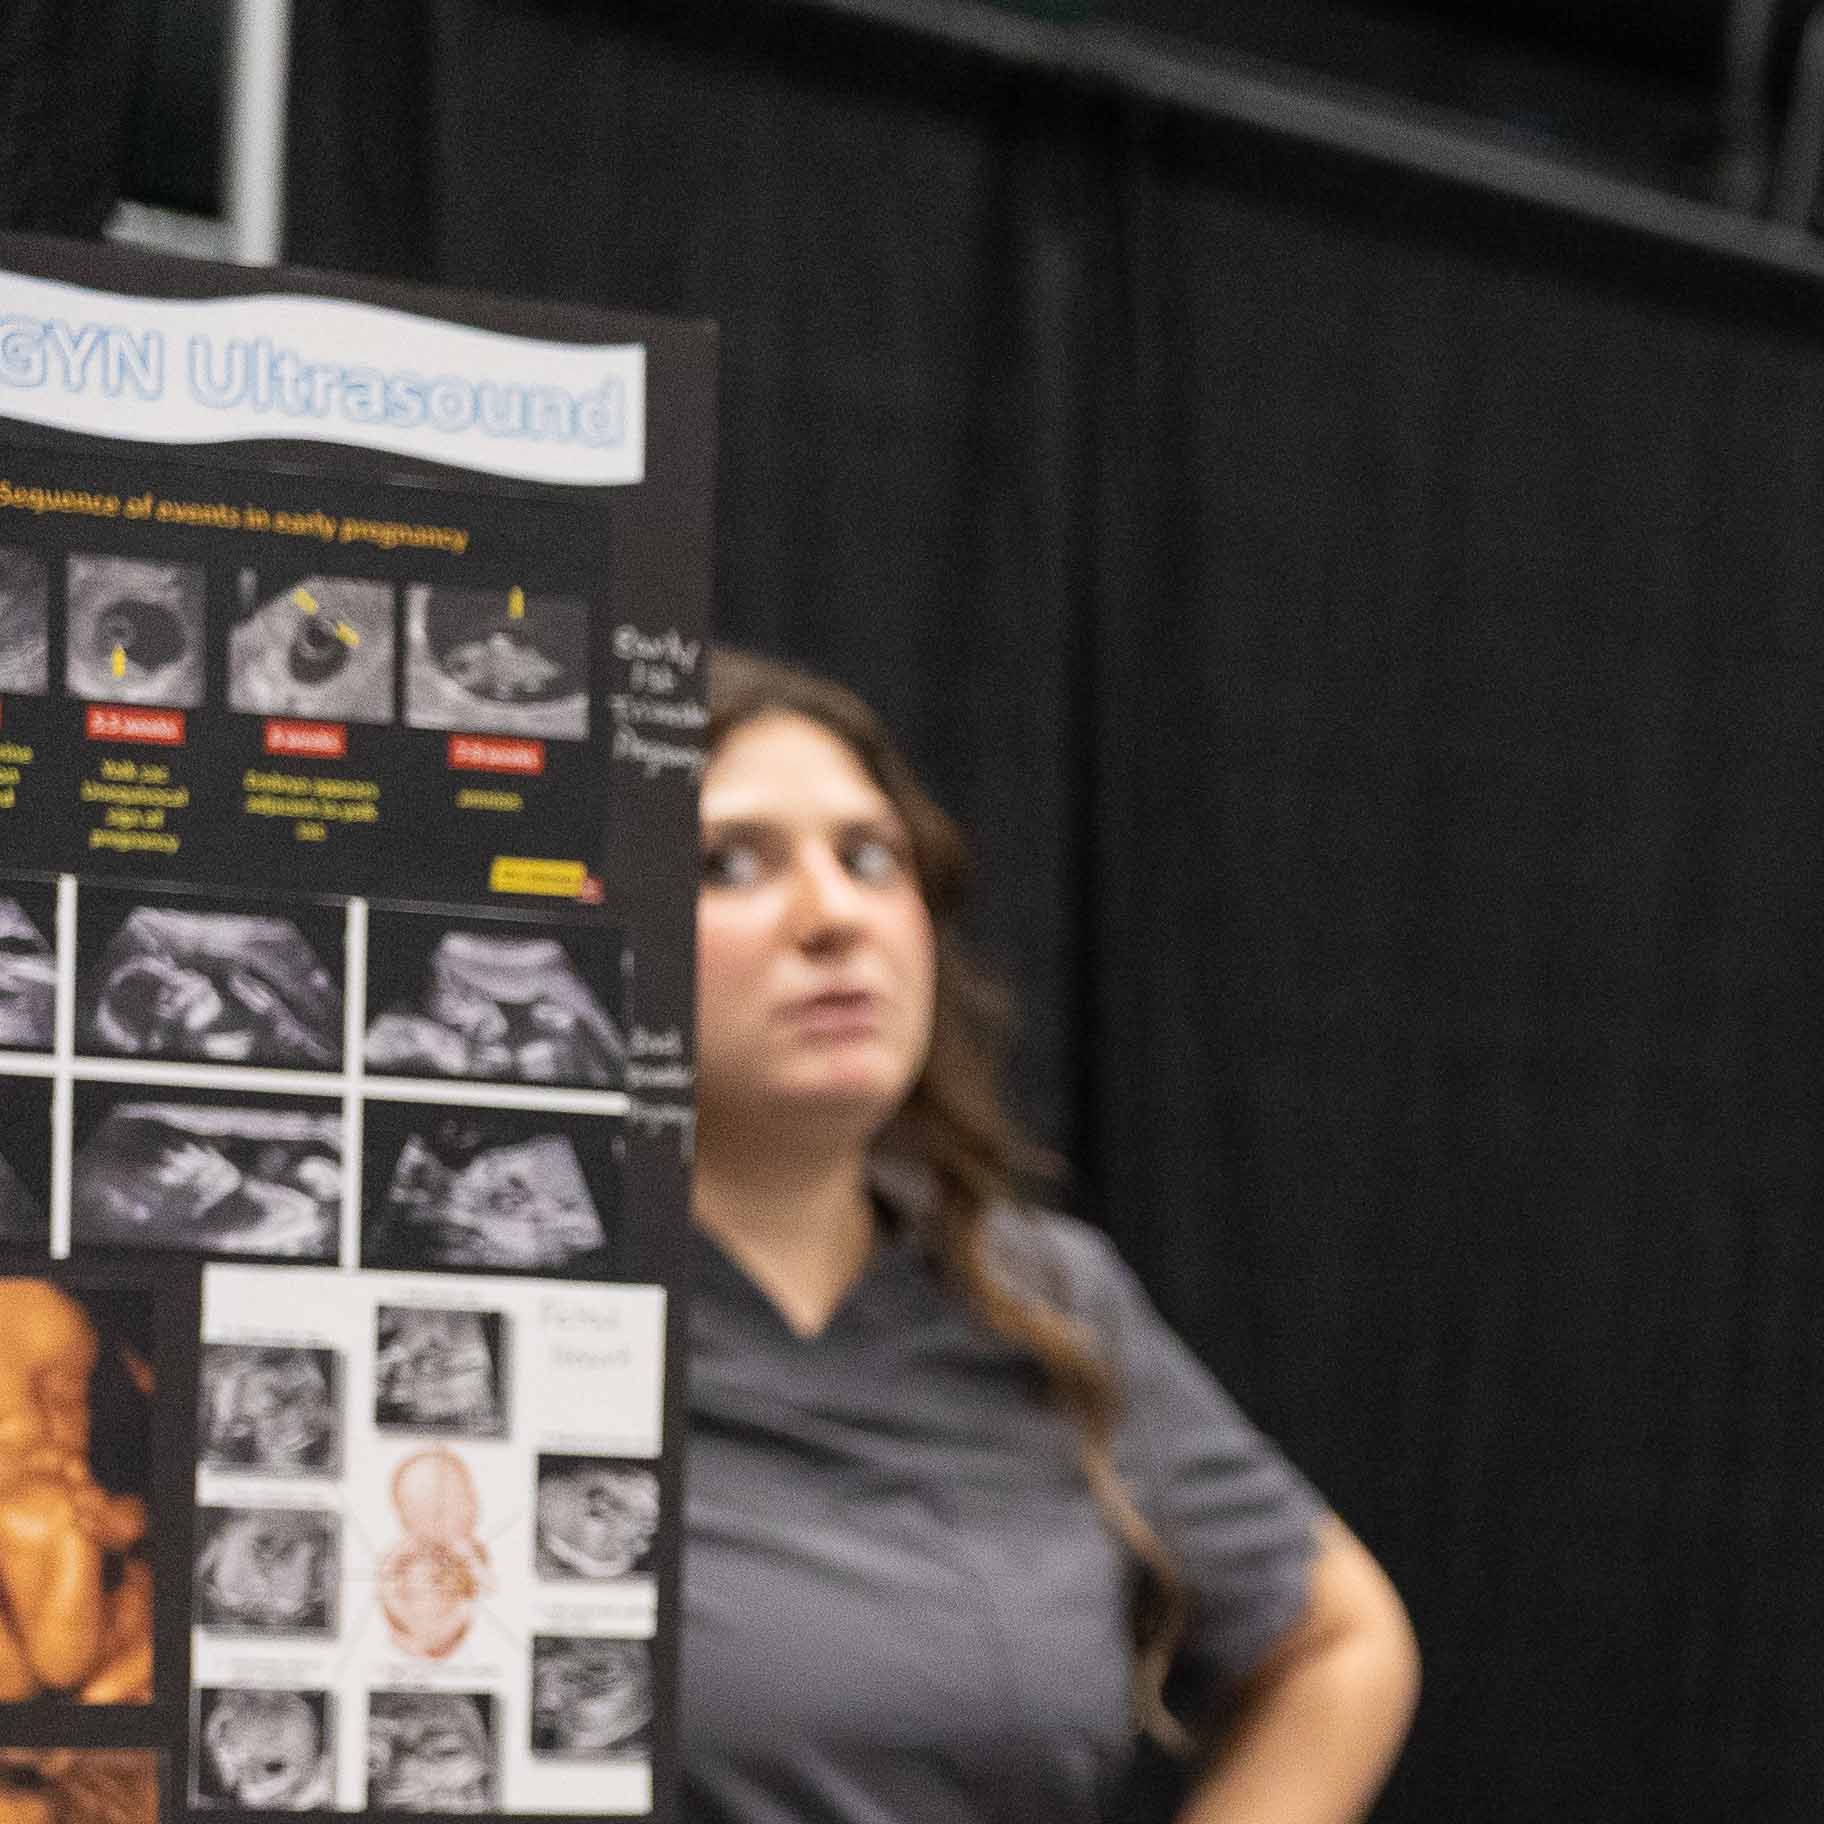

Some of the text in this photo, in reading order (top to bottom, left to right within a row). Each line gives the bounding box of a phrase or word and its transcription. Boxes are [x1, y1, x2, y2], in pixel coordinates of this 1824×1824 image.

[190, 333, 624, 447] Ultrasound
[123, 489, 152, 519] of
[156, 501, 240, 528] events
[242, 504, 271, 532] in
[272, 511, 337, 543] early
[338, 517, 468, 553] pregnancy
